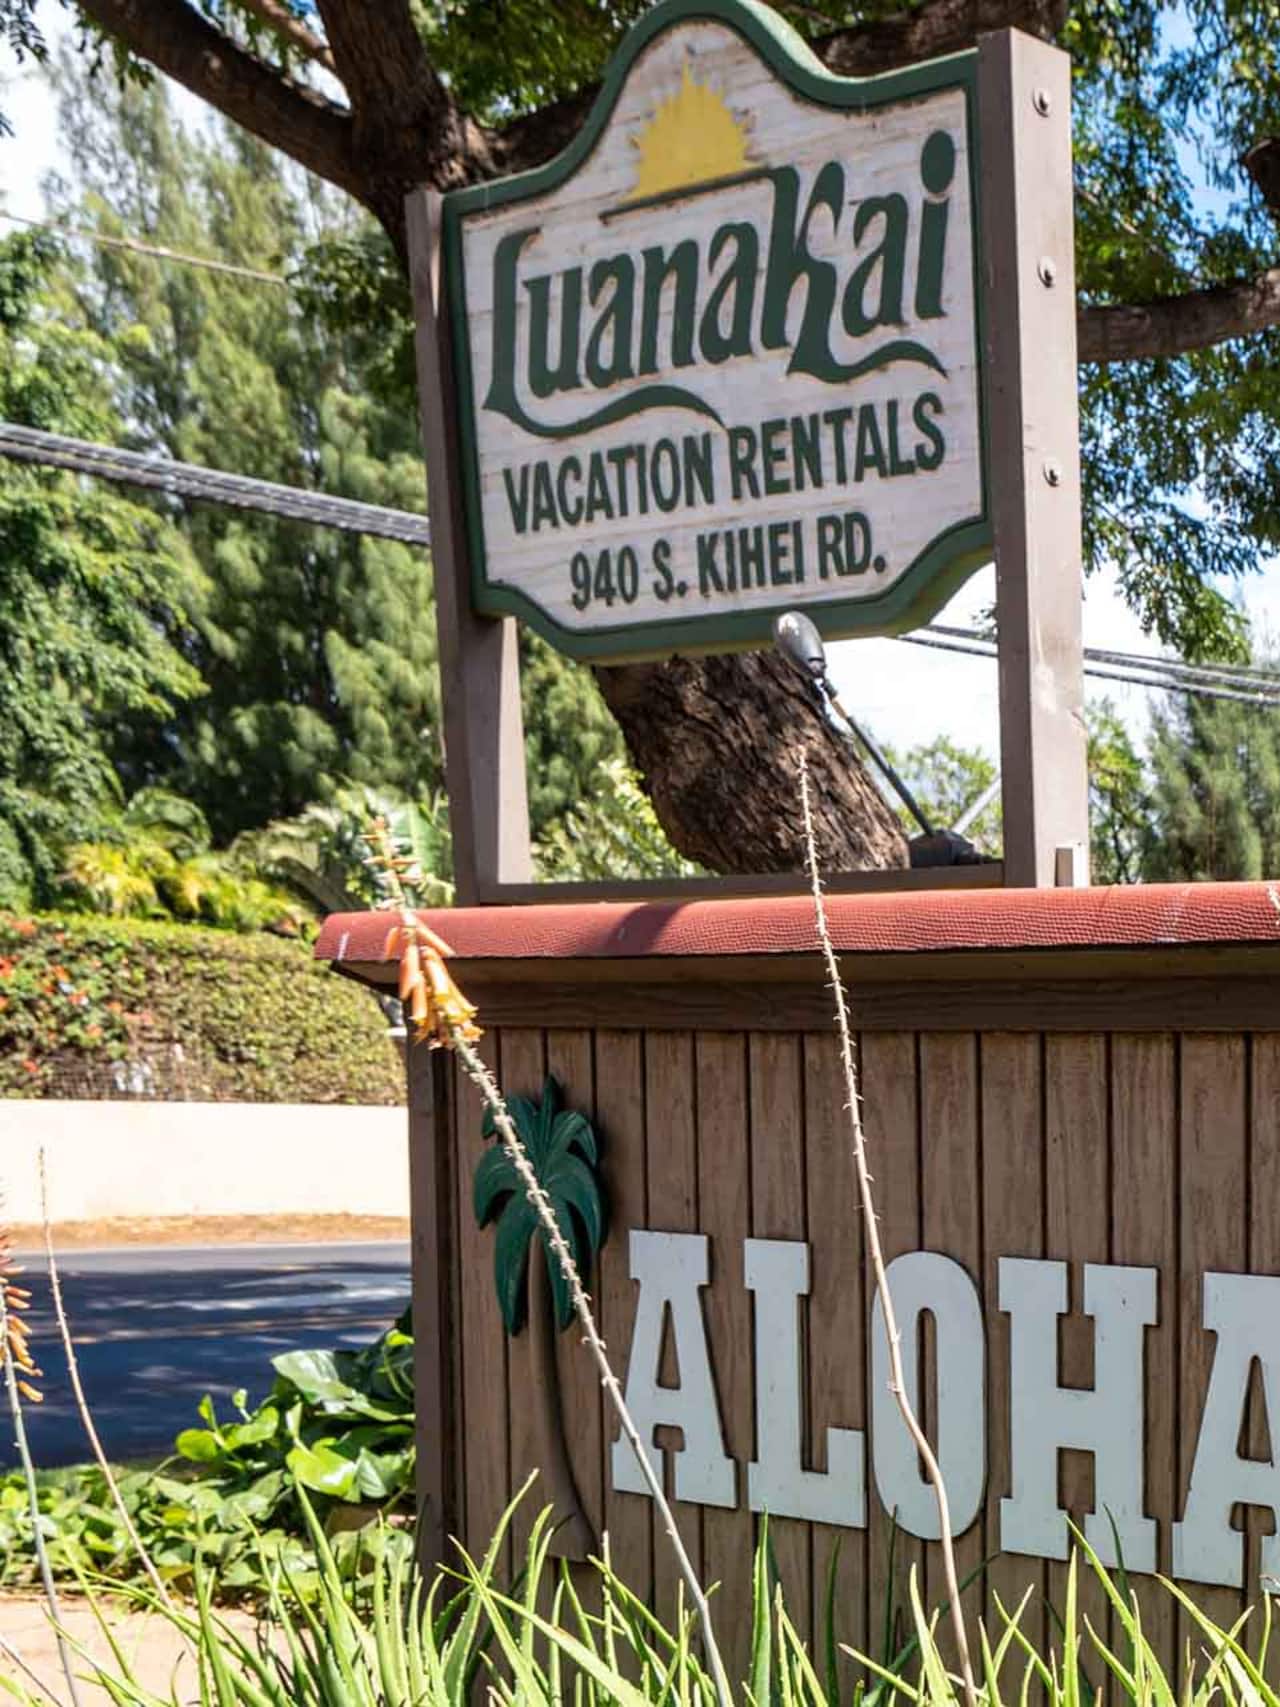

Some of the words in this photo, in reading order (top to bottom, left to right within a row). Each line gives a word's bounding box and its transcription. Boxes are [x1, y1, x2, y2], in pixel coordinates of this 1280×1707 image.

[503, 430, 716, 533] VACATION
[729, 391, 947, 500] RENTALS
[570, 538, 640, 611] 940
[652, 535, 687, 600] S.
[698, 519, 804, 594] KIHEI
[817, 511, 887, 576] RD.
